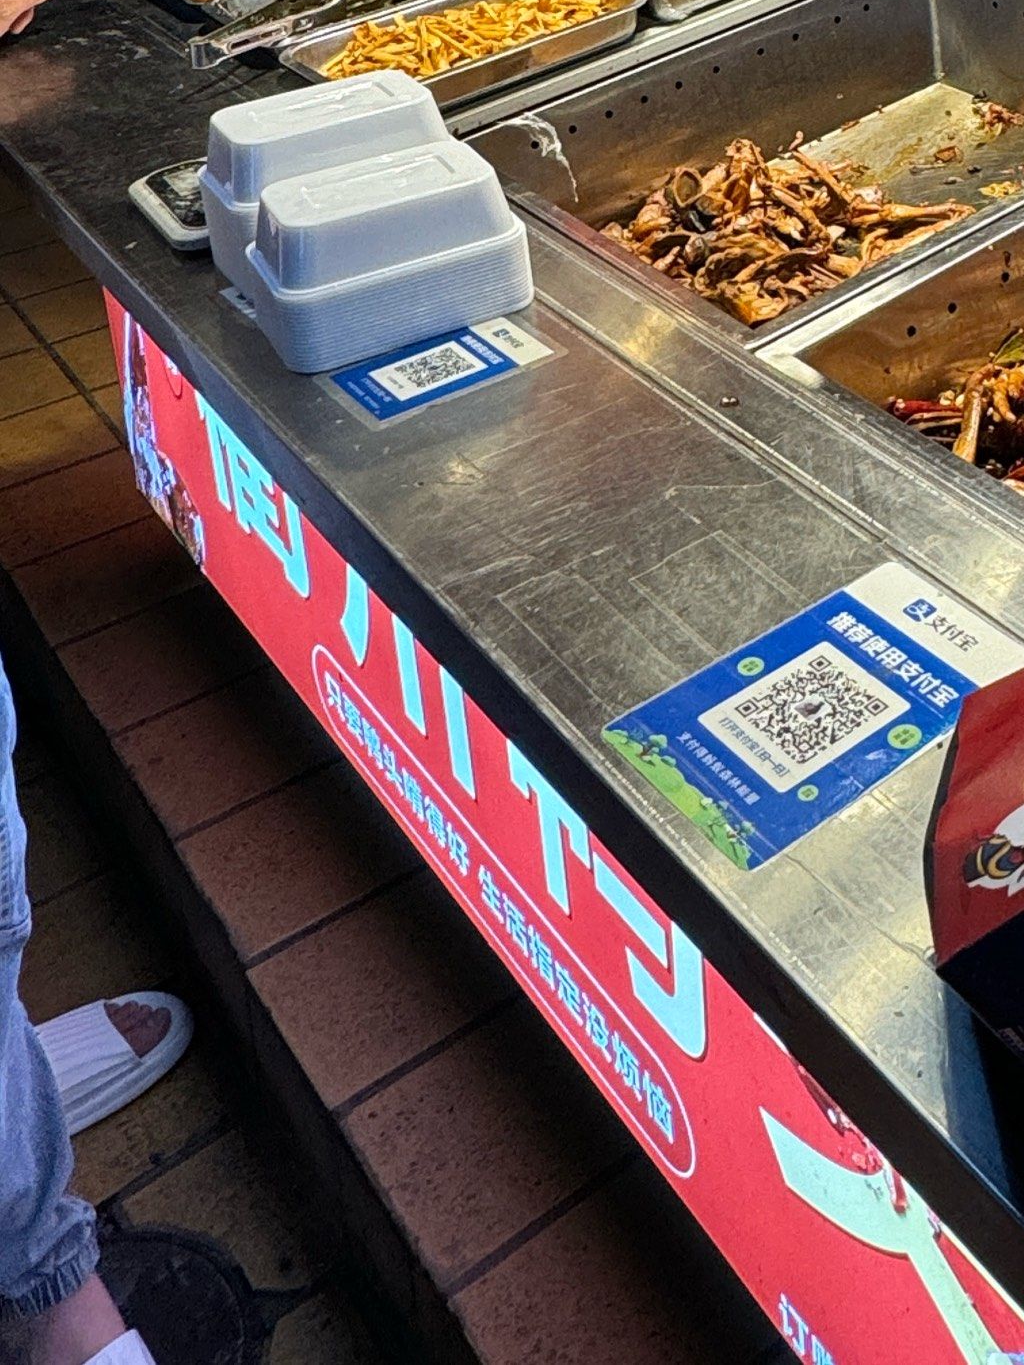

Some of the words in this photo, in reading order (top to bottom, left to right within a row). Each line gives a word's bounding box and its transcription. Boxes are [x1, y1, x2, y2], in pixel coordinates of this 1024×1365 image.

[825, 610, 961, 709] 推荐使用支付宝
[924, 614, 980, 654] 支付宝
